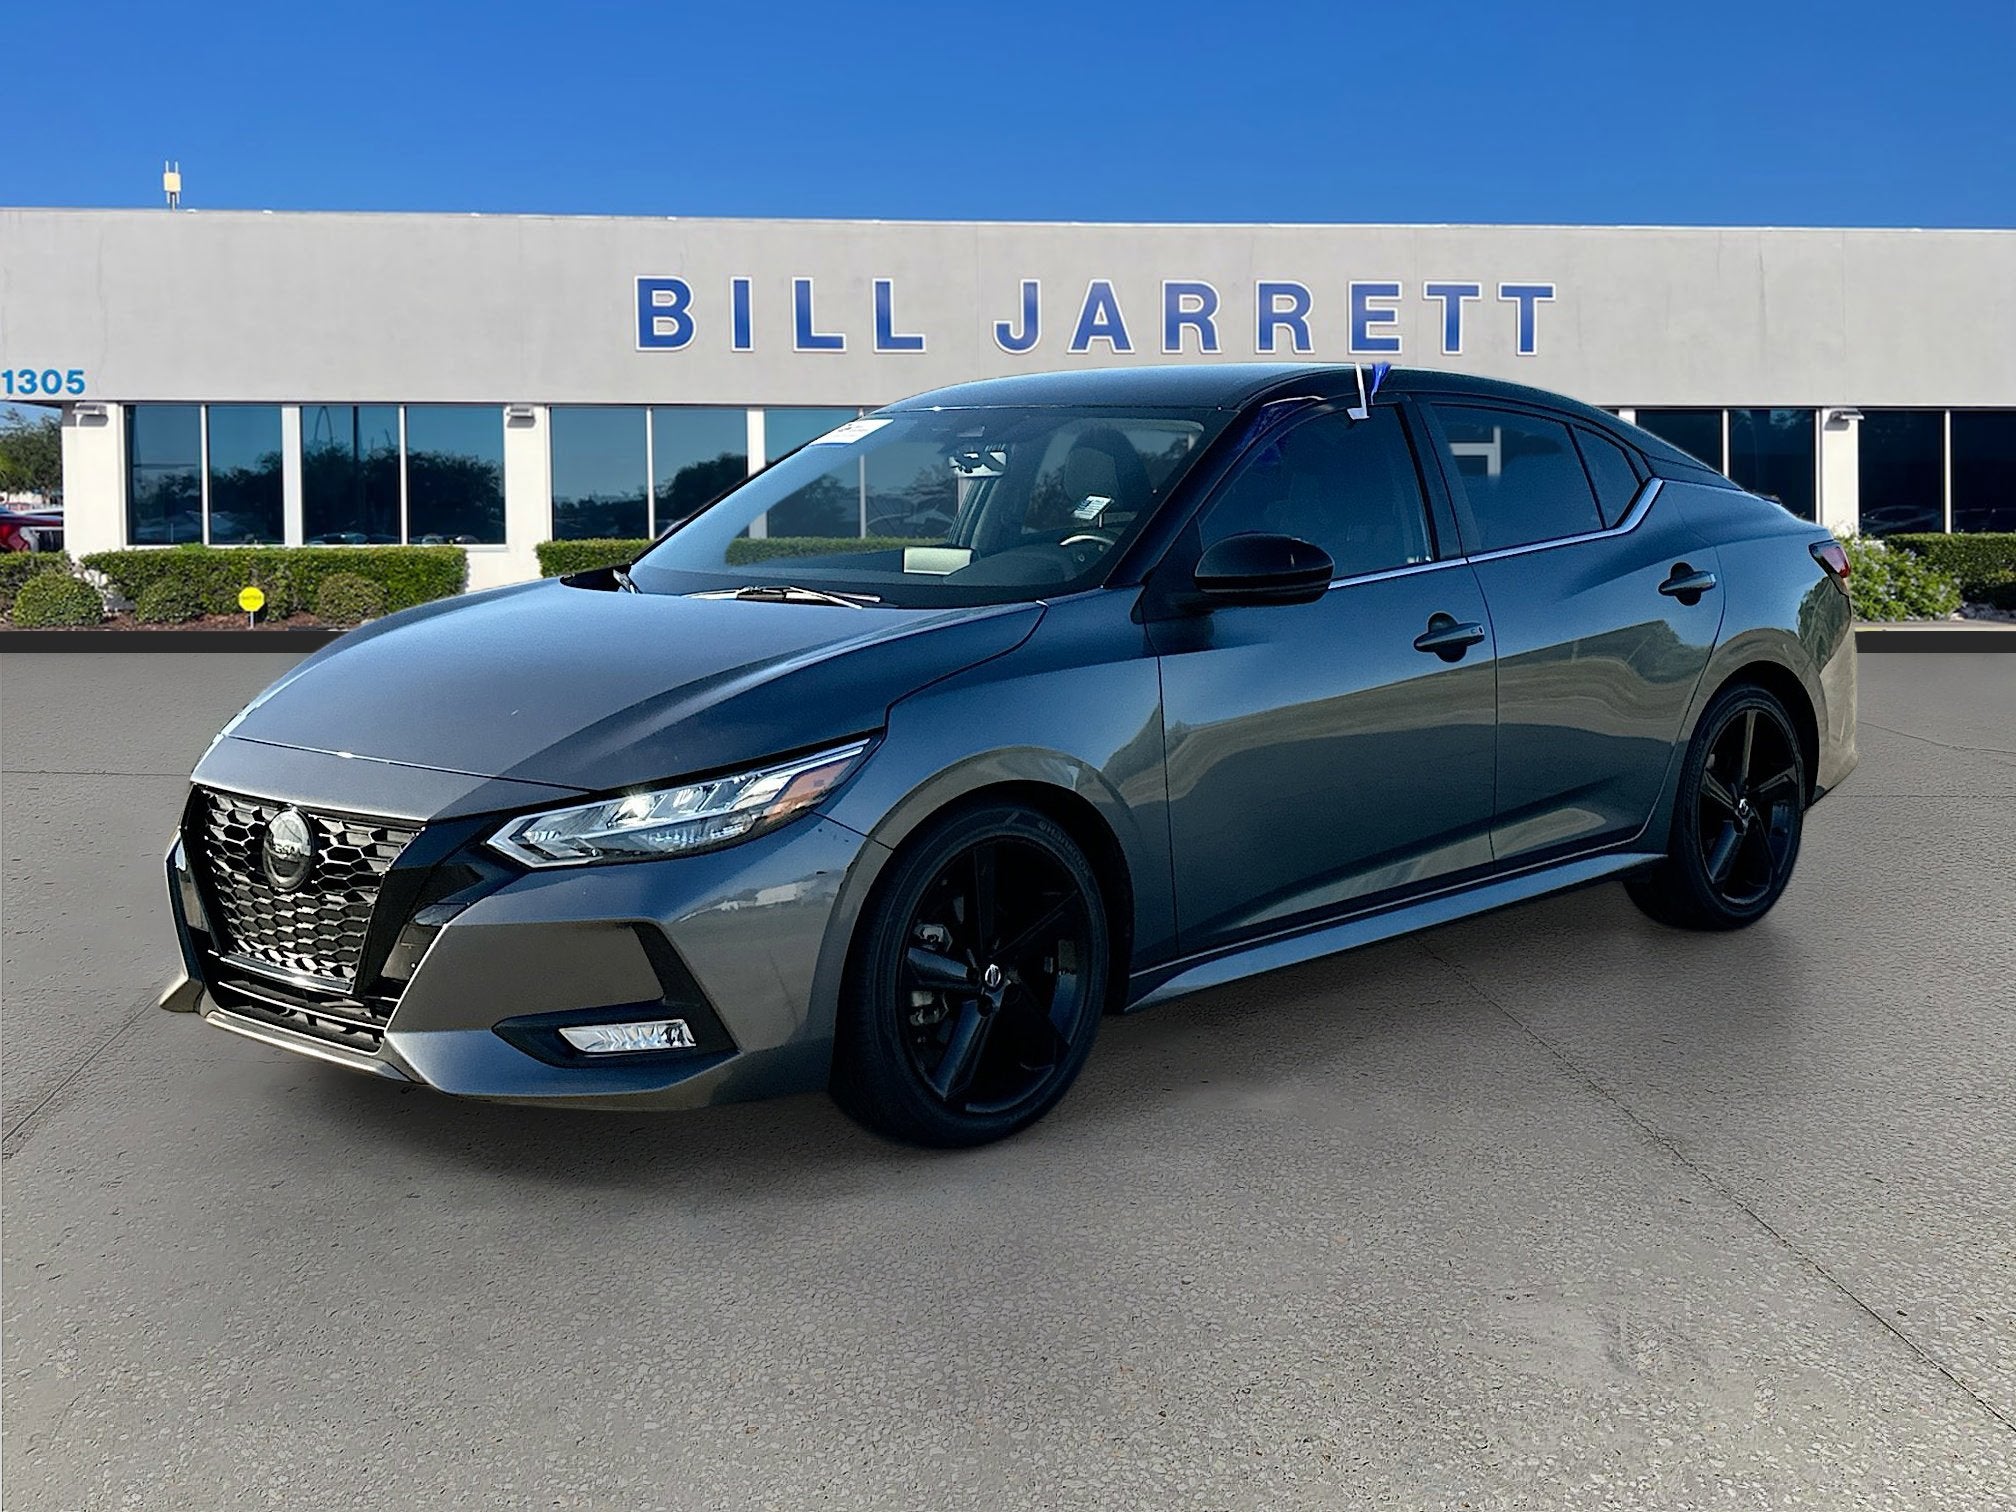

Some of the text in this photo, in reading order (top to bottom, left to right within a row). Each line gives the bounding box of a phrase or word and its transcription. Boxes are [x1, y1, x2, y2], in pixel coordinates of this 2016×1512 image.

[634, 274, 1555, 356] BILL JARRETT
[1, 368, 86, 395] 1305
